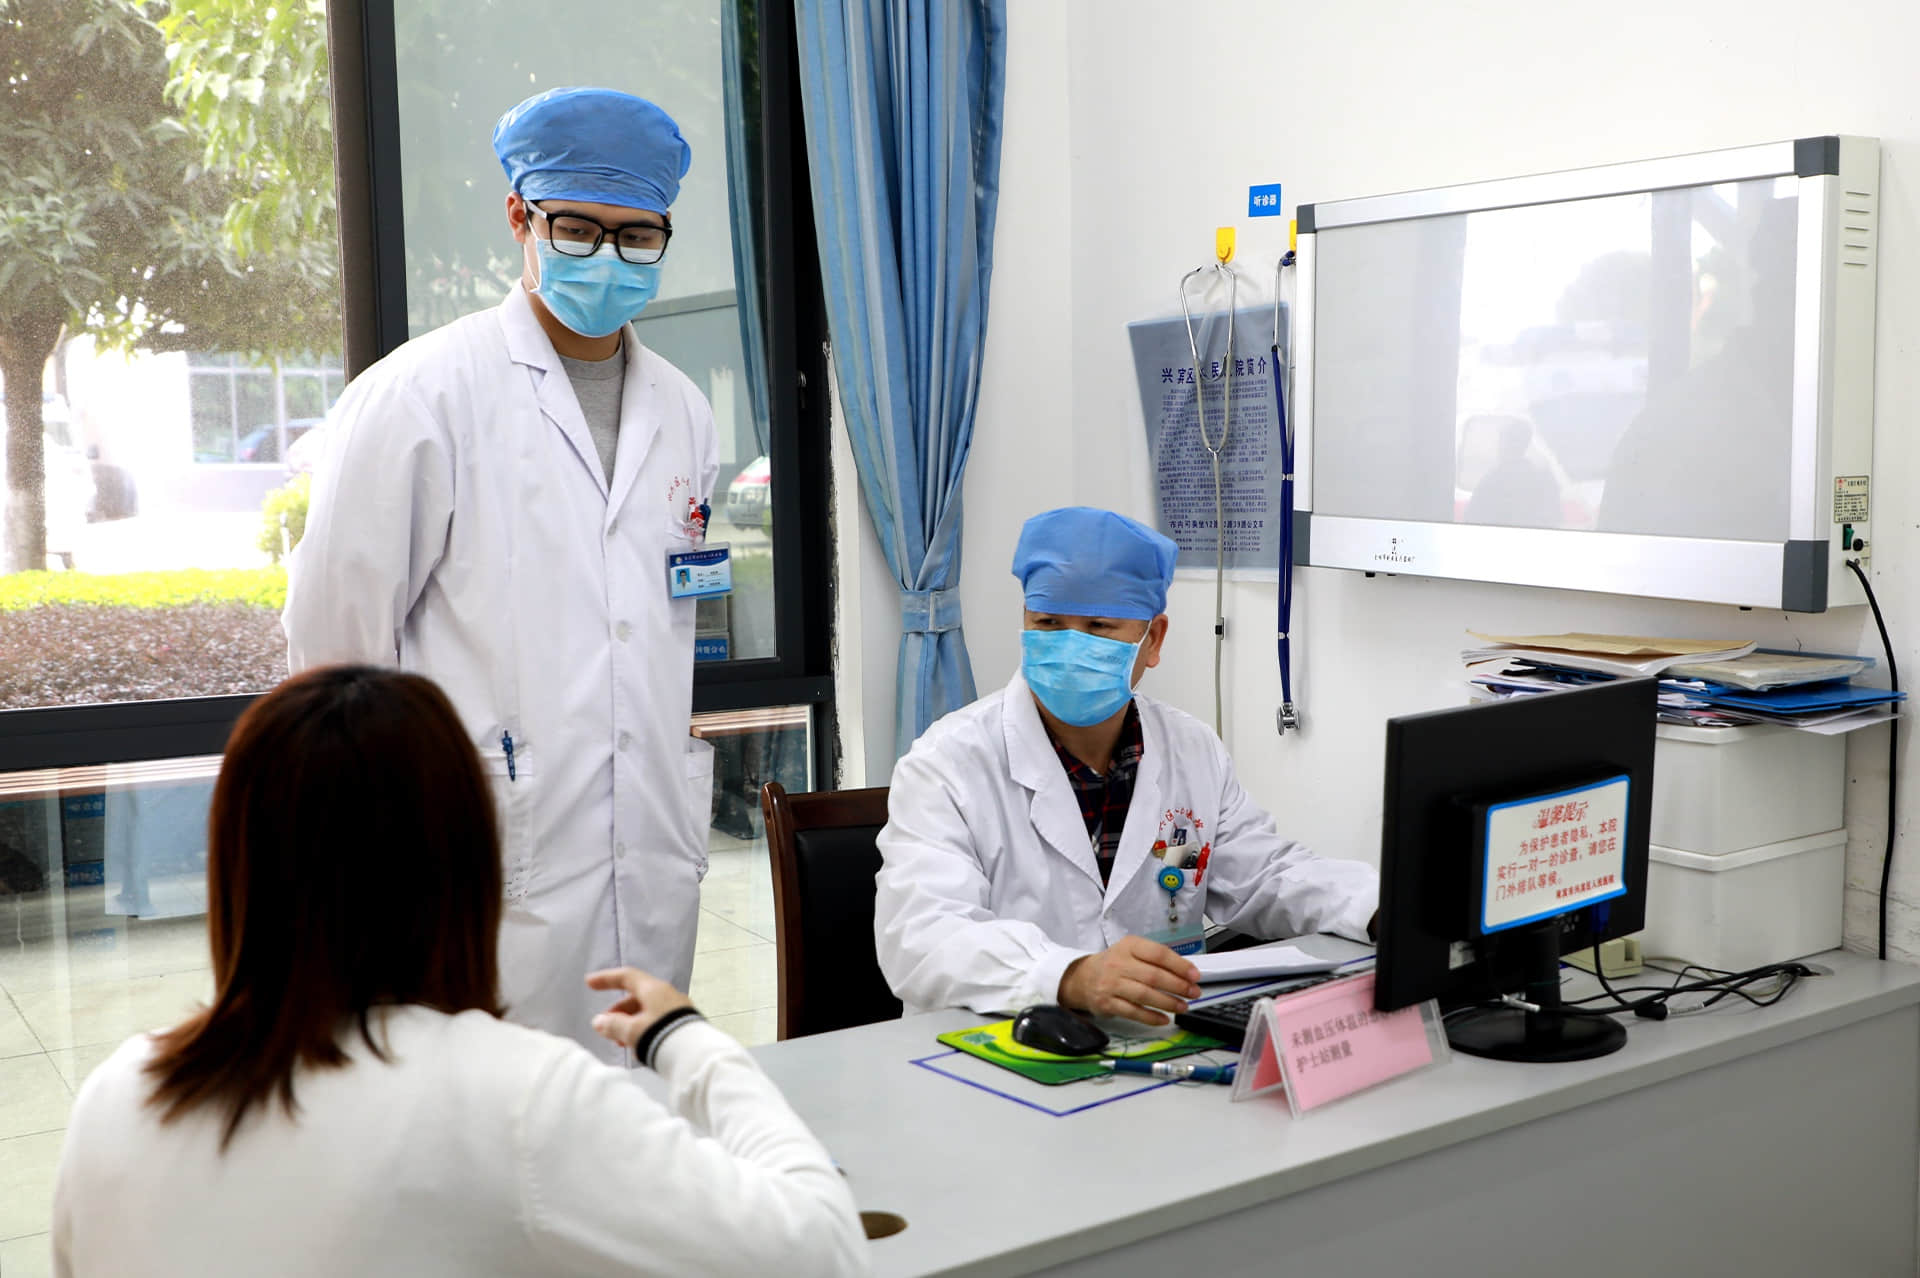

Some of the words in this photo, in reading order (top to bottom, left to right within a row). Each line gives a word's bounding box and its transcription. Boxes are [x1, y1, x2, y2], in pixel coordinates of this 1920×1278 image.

[1253, 193, 1277, 208] 听诊器
[1161, 356, 1267, 385] 兴宾区人民院简介
[1532, 800, 1589, 829] 温馨提示
[1295, 1039, 1353, 1074] 护士站测量
